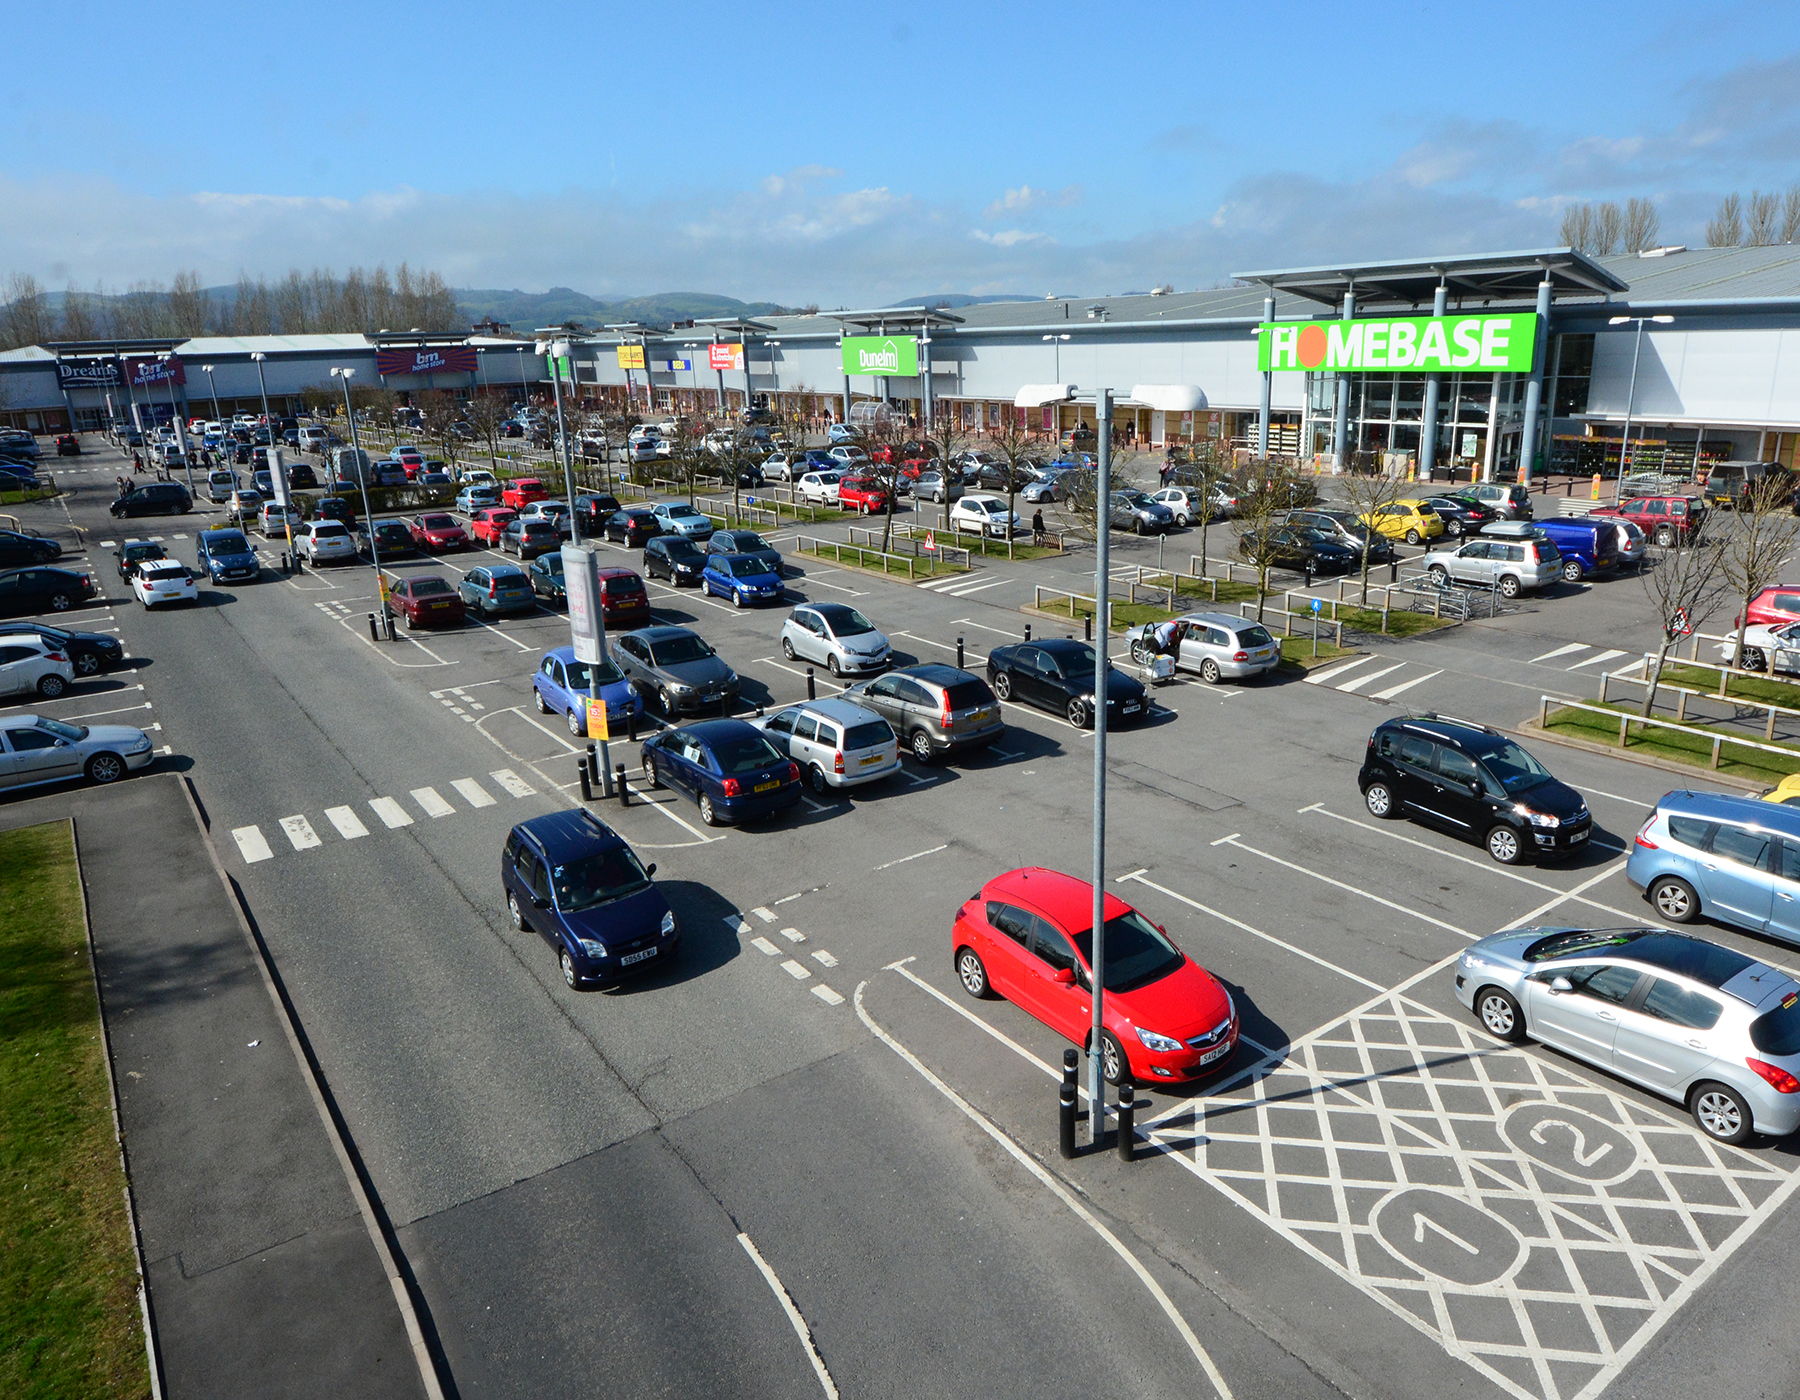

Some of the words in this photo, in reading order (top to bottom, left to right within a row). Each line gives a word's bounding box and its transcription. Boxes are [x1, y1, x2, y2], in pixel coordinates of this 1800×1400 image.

[859, 348, 896, 367] Dunelm
[1271, 318, 1512, 368] HOMEBASE
[59, 364, 118, 378] Dreams
[1529, 1119, 1613, 1167] 2
[1413, 1211, 1480, 1256] 1
